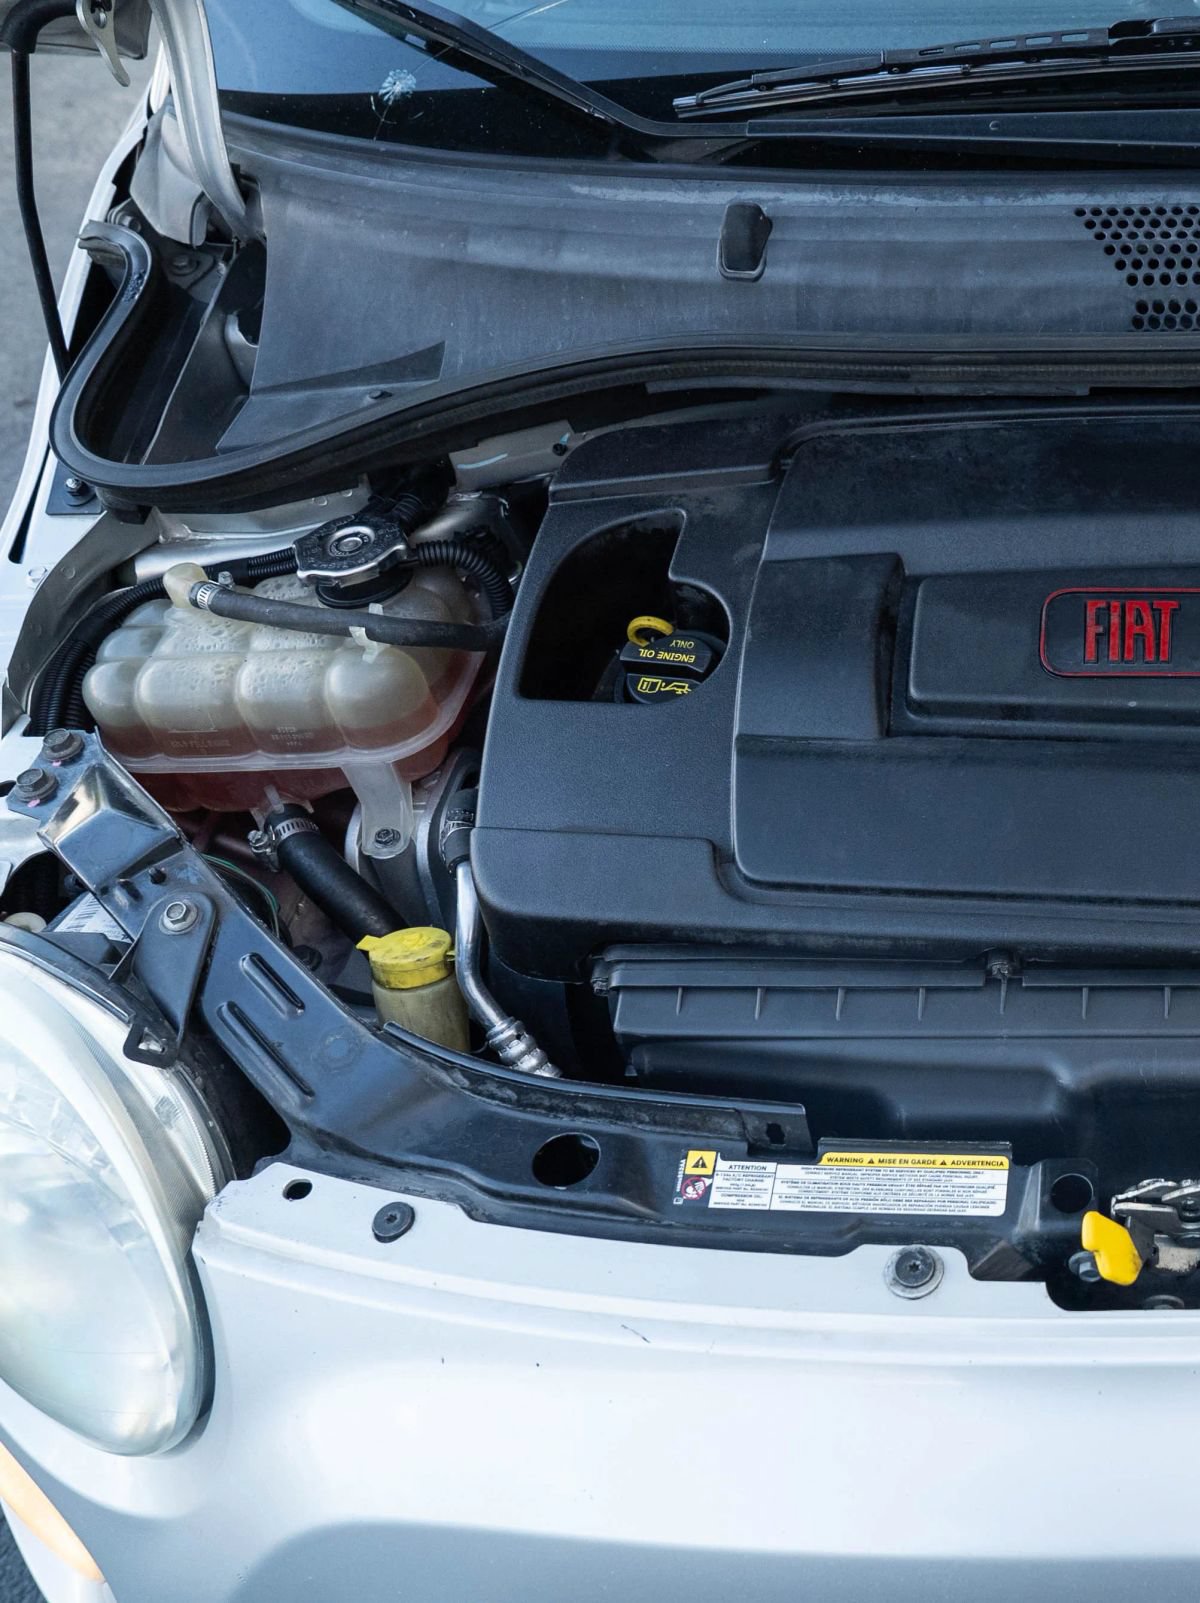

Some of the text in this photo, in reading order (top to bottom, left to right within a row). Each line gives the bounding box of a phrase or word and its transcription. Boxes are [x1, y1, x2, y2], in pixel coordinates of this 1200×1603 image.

[1084, 600, 1180, 664] FIAT
[669, 639, 694, 649] ONLY
[638, 648, 696, 663] ENGINE OIL
